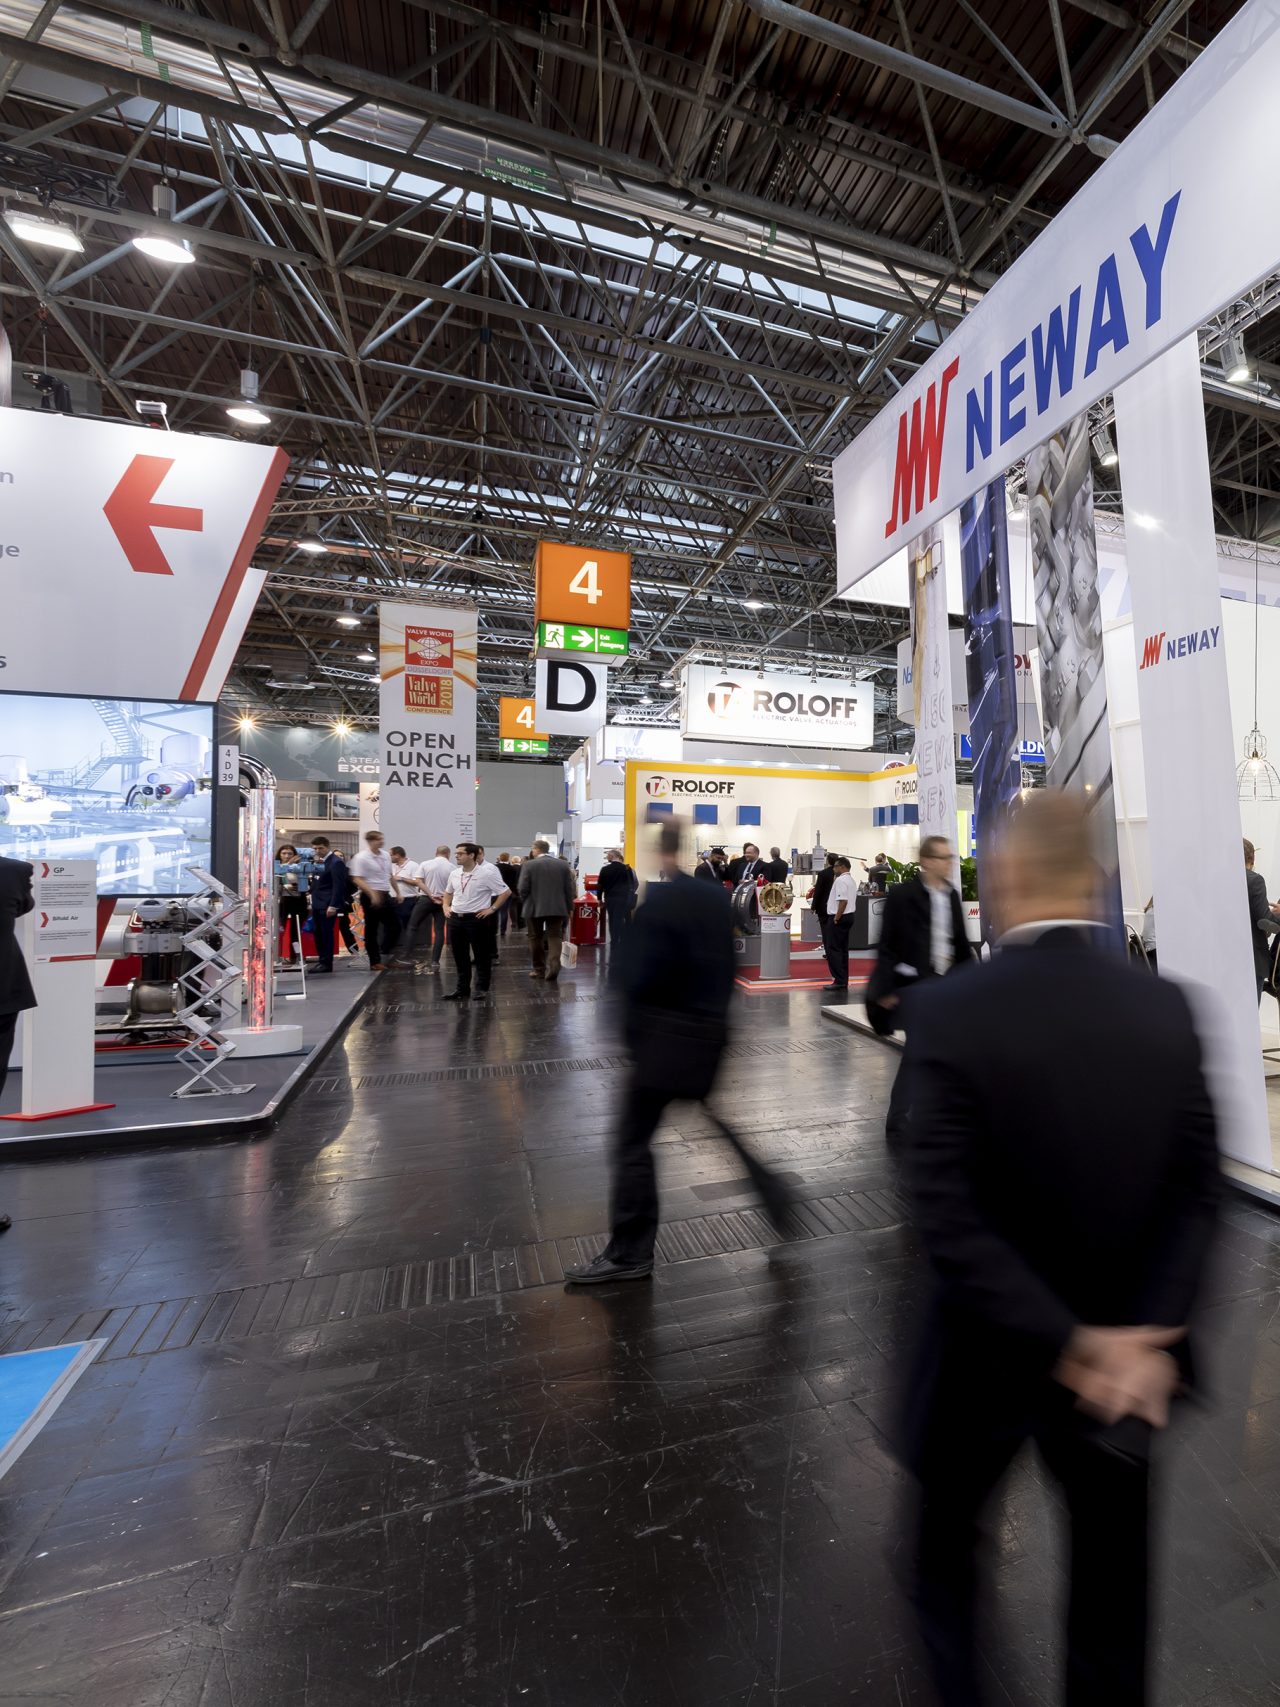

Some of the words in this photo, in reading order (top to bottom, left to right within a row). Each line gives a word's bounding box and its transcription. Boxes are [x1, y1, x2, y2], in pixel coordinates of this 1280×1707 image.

[966, 188, 1182, 474] NEWAY
[569, 561, 602, 604] 4
[429, 630, 452, 638] WORLD
[1168, 626, 1220, 660] NEWAY
[408, 676, 436, 692] Valve
[440, 679, 452, 706] 2018
[546, 660, 597, 713] D
[406, 706, 452, 714] CONFERENCE
[754, 690, 858, 718] ROLOFF
[516, 706, 534, 728] 4
[386, 731, 454, 749] OPEN
[225, 749, 231, 757] 4
[387, 751, 470, 769] LUNCH
[225, 762, 232, 770] D
[222, 774, 234, 782] 39
[386, 771, 454, 788] AREA
[672, 780, 735, 794] ROLOFF
